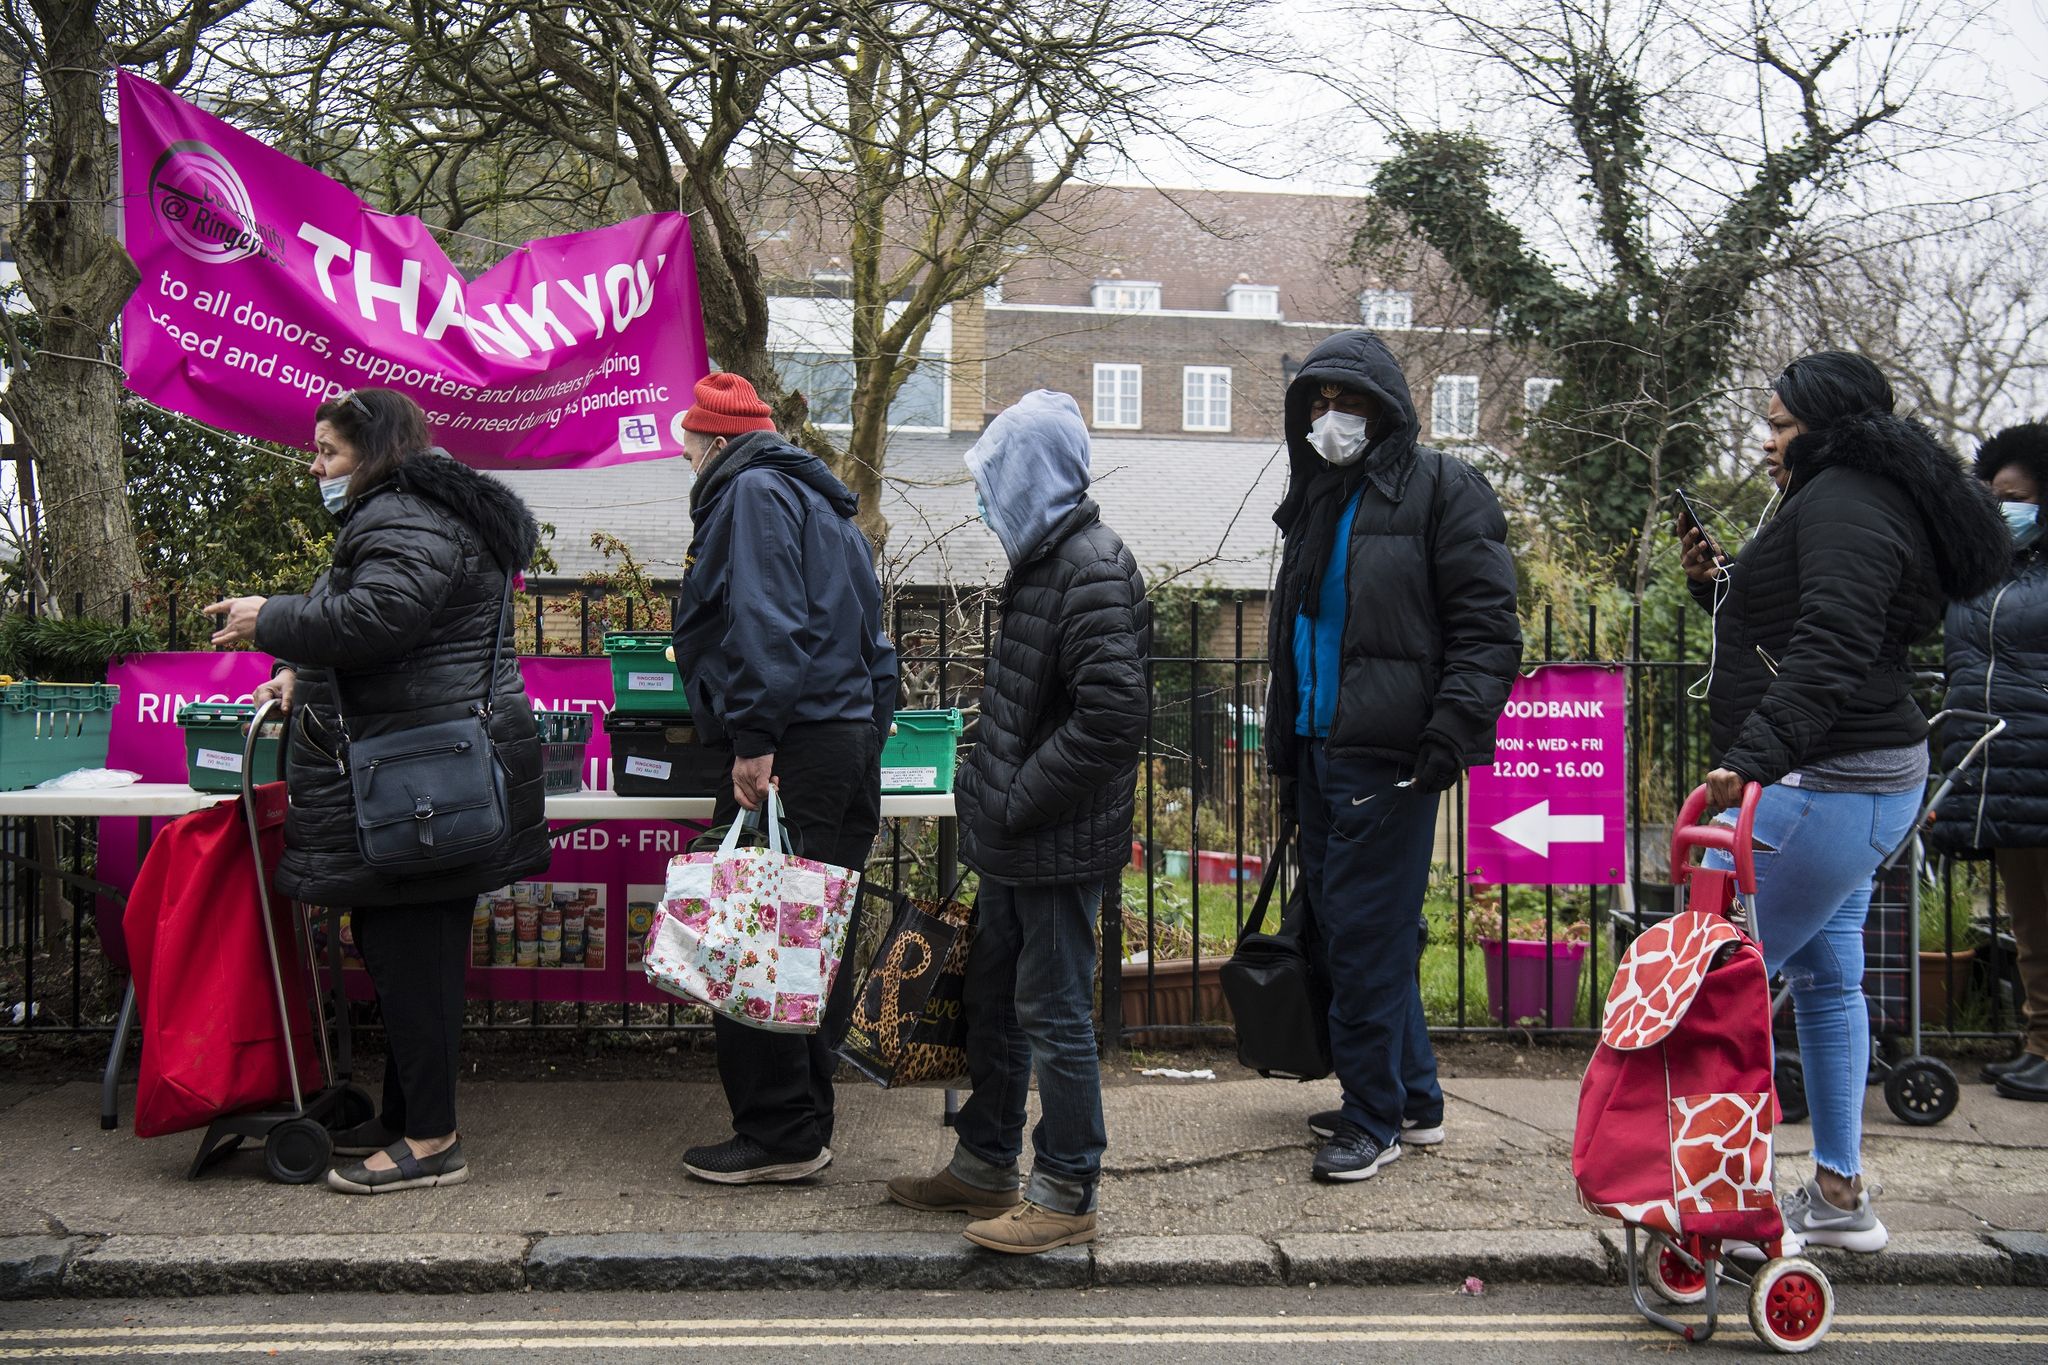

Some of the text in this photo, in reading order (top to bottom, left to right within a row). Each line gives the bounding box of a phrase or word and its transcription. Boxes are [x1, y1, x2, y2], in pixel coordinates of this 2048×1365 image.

[297, 221, 578, 359] THANK
[159, 270, 188, 301] to
[193, 290, 231, 318] all
[233, 301, 333, 359] donors,
[339, 347, 478, 400] supporters
[476, 385, 517, 404] and
[515, 374, 582, 403] volunteers
[223, 345, 278, 378] and
[278, 363, 346, 403] supp
[450, 411, 473, 429] in
[472, 414, 521, 432] need
[518, 407, 562, 429] during
[581, 383, 670, 418] pandemic
[1503, 700, 1605, 718] OODBANK
[1495, 738, 1524, 751] MON
[1537, 738, 1568, 751] WED
[1581, 738, 1604, 751] FRI
[1493, 762, 1540, 778] 12.00
[1556, 762, 1605, 778] 16.00
[548, 827, 610, 850] WED
[639, 829, 680, 852] FRI
[925, 996, 961, 1021] ove
